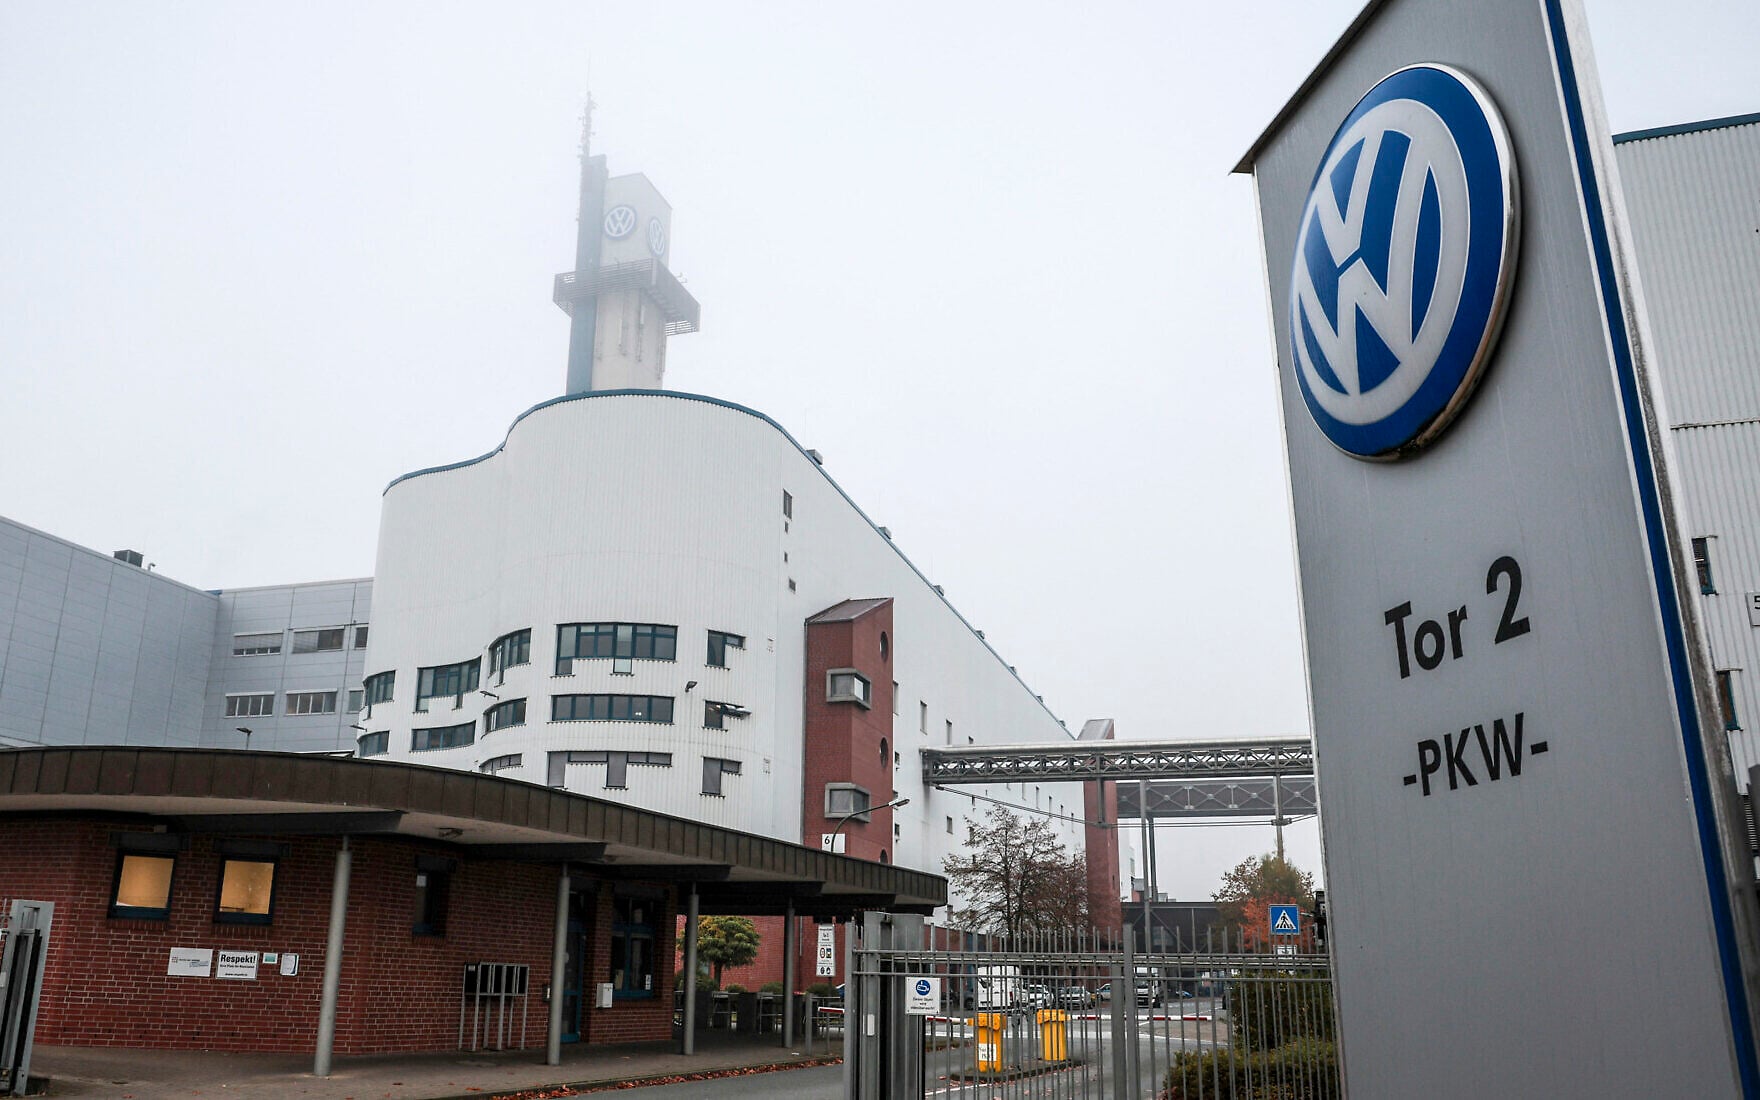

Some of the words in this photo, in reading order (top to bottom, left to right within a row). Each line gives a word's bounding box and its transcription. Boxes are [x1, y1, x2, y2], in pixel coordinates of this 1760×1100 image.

[604, 206, 636, 238] VW
[1290, 98, 1472, 426] VW
[1384, 600, 1468, 680] Tor
[1486, 555, 1531, 645] 2
[1403, 711, 1549, 797] -PKW-
[824, 835, 831, 845] 6
[220, 953, 256, 965] Respekt!
